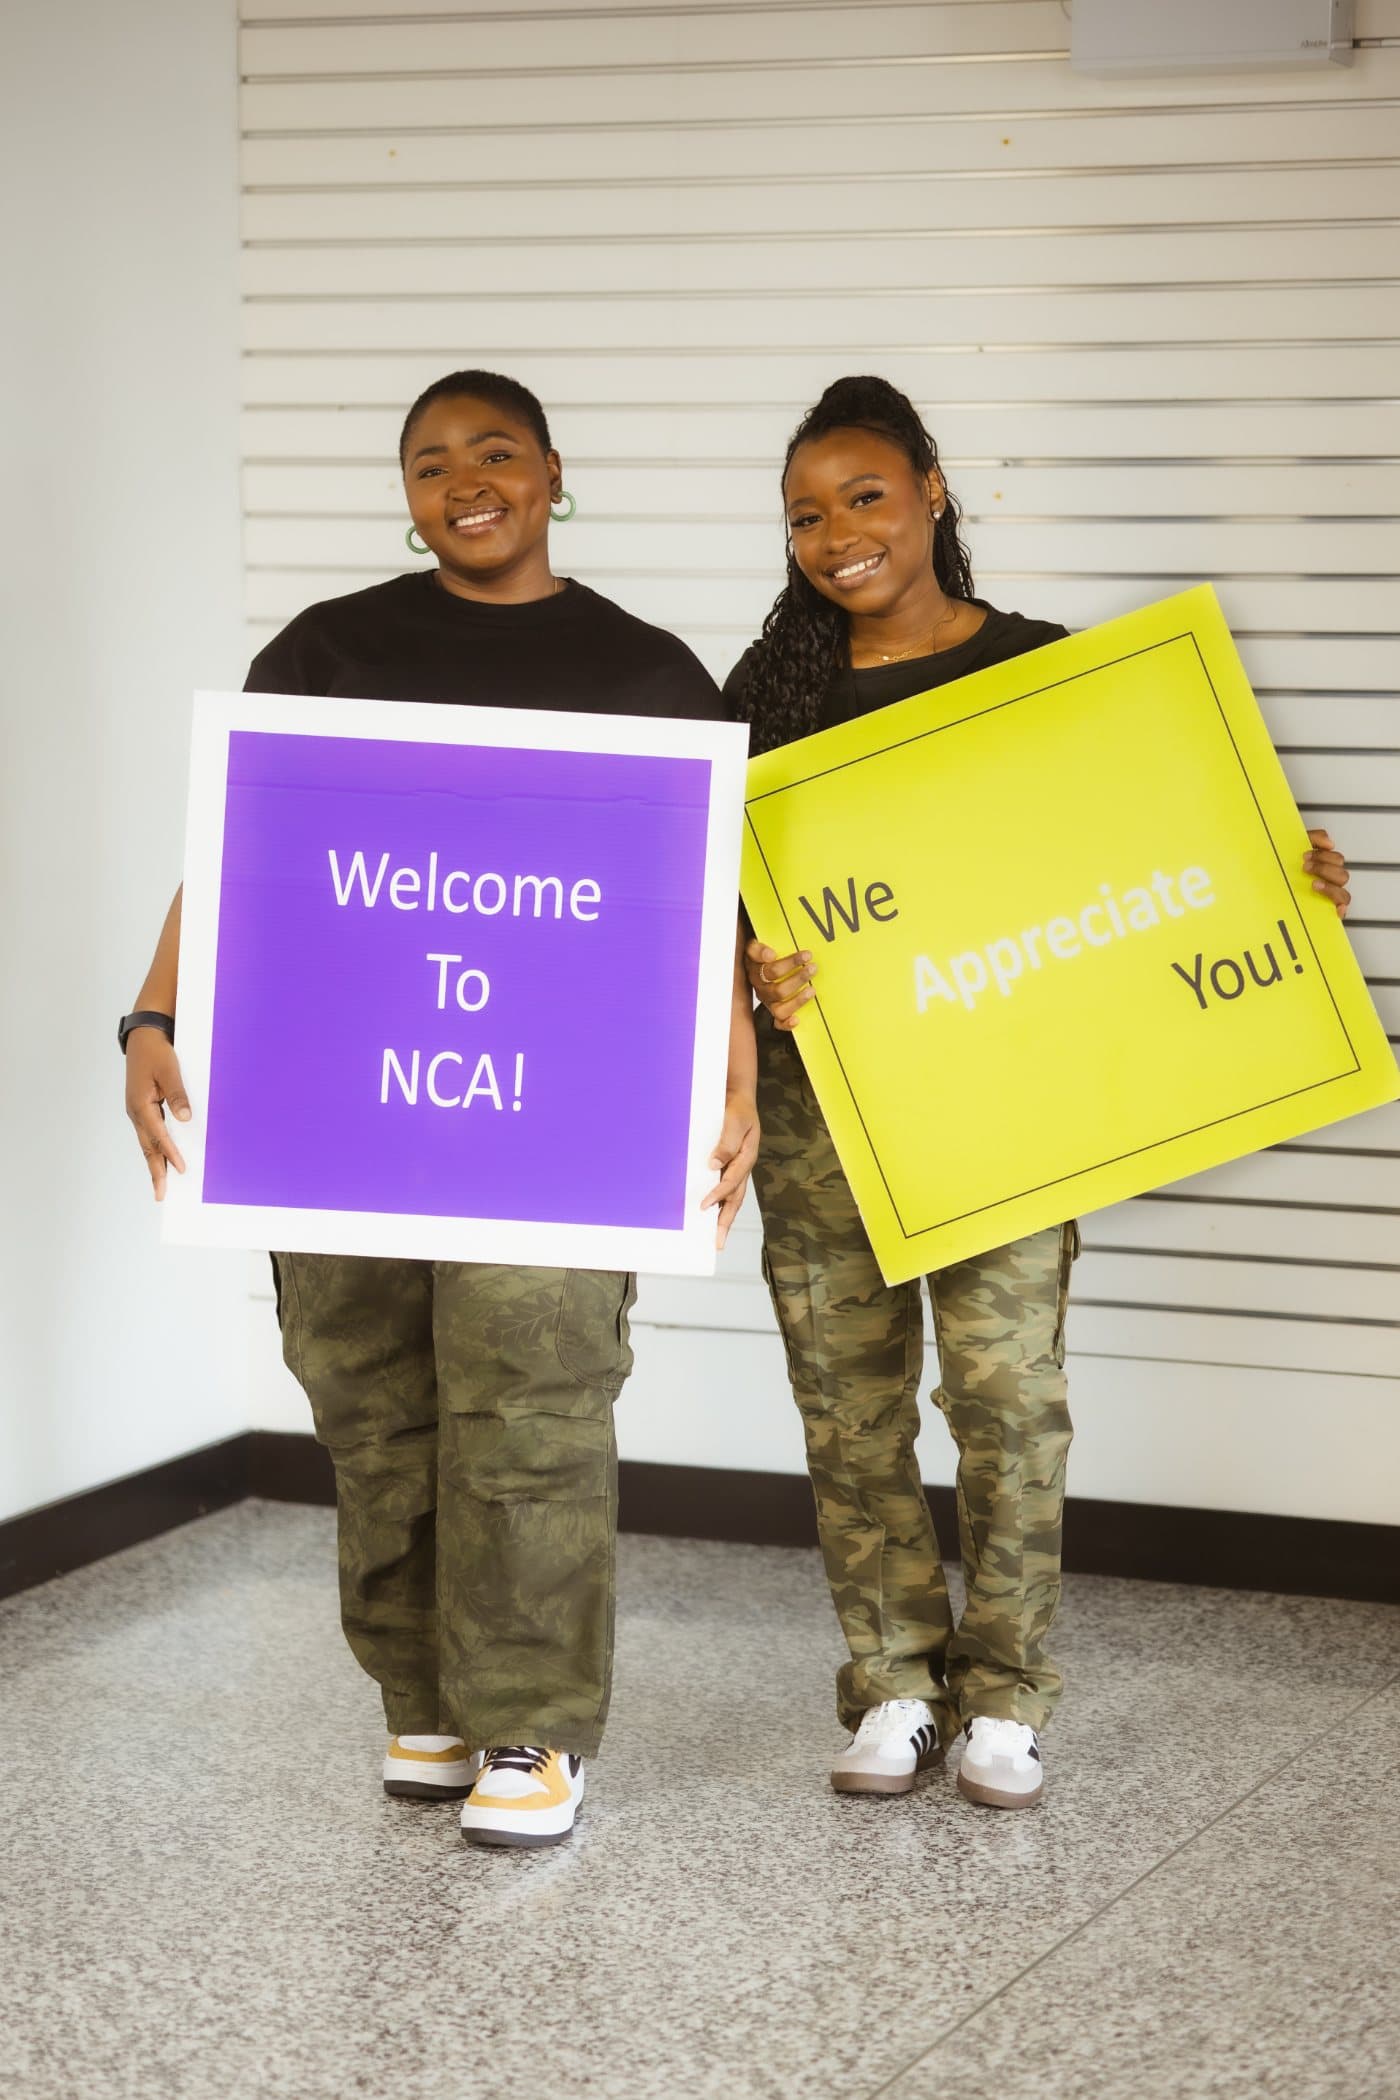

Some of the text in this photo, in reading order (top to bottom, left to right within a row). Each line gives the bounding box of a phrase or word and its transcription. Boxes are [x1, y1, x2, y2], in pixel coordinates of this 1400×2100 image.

[328, 849, 602, 921] Welcome
[799, 877, 899, 943] We
[912, 864, 1218, 1015] Appreciate
[1171, 919, 1305, 1010] You!
[426, 953, 490, 1012] To
[380, 1048, 525, 1112] NCA!
